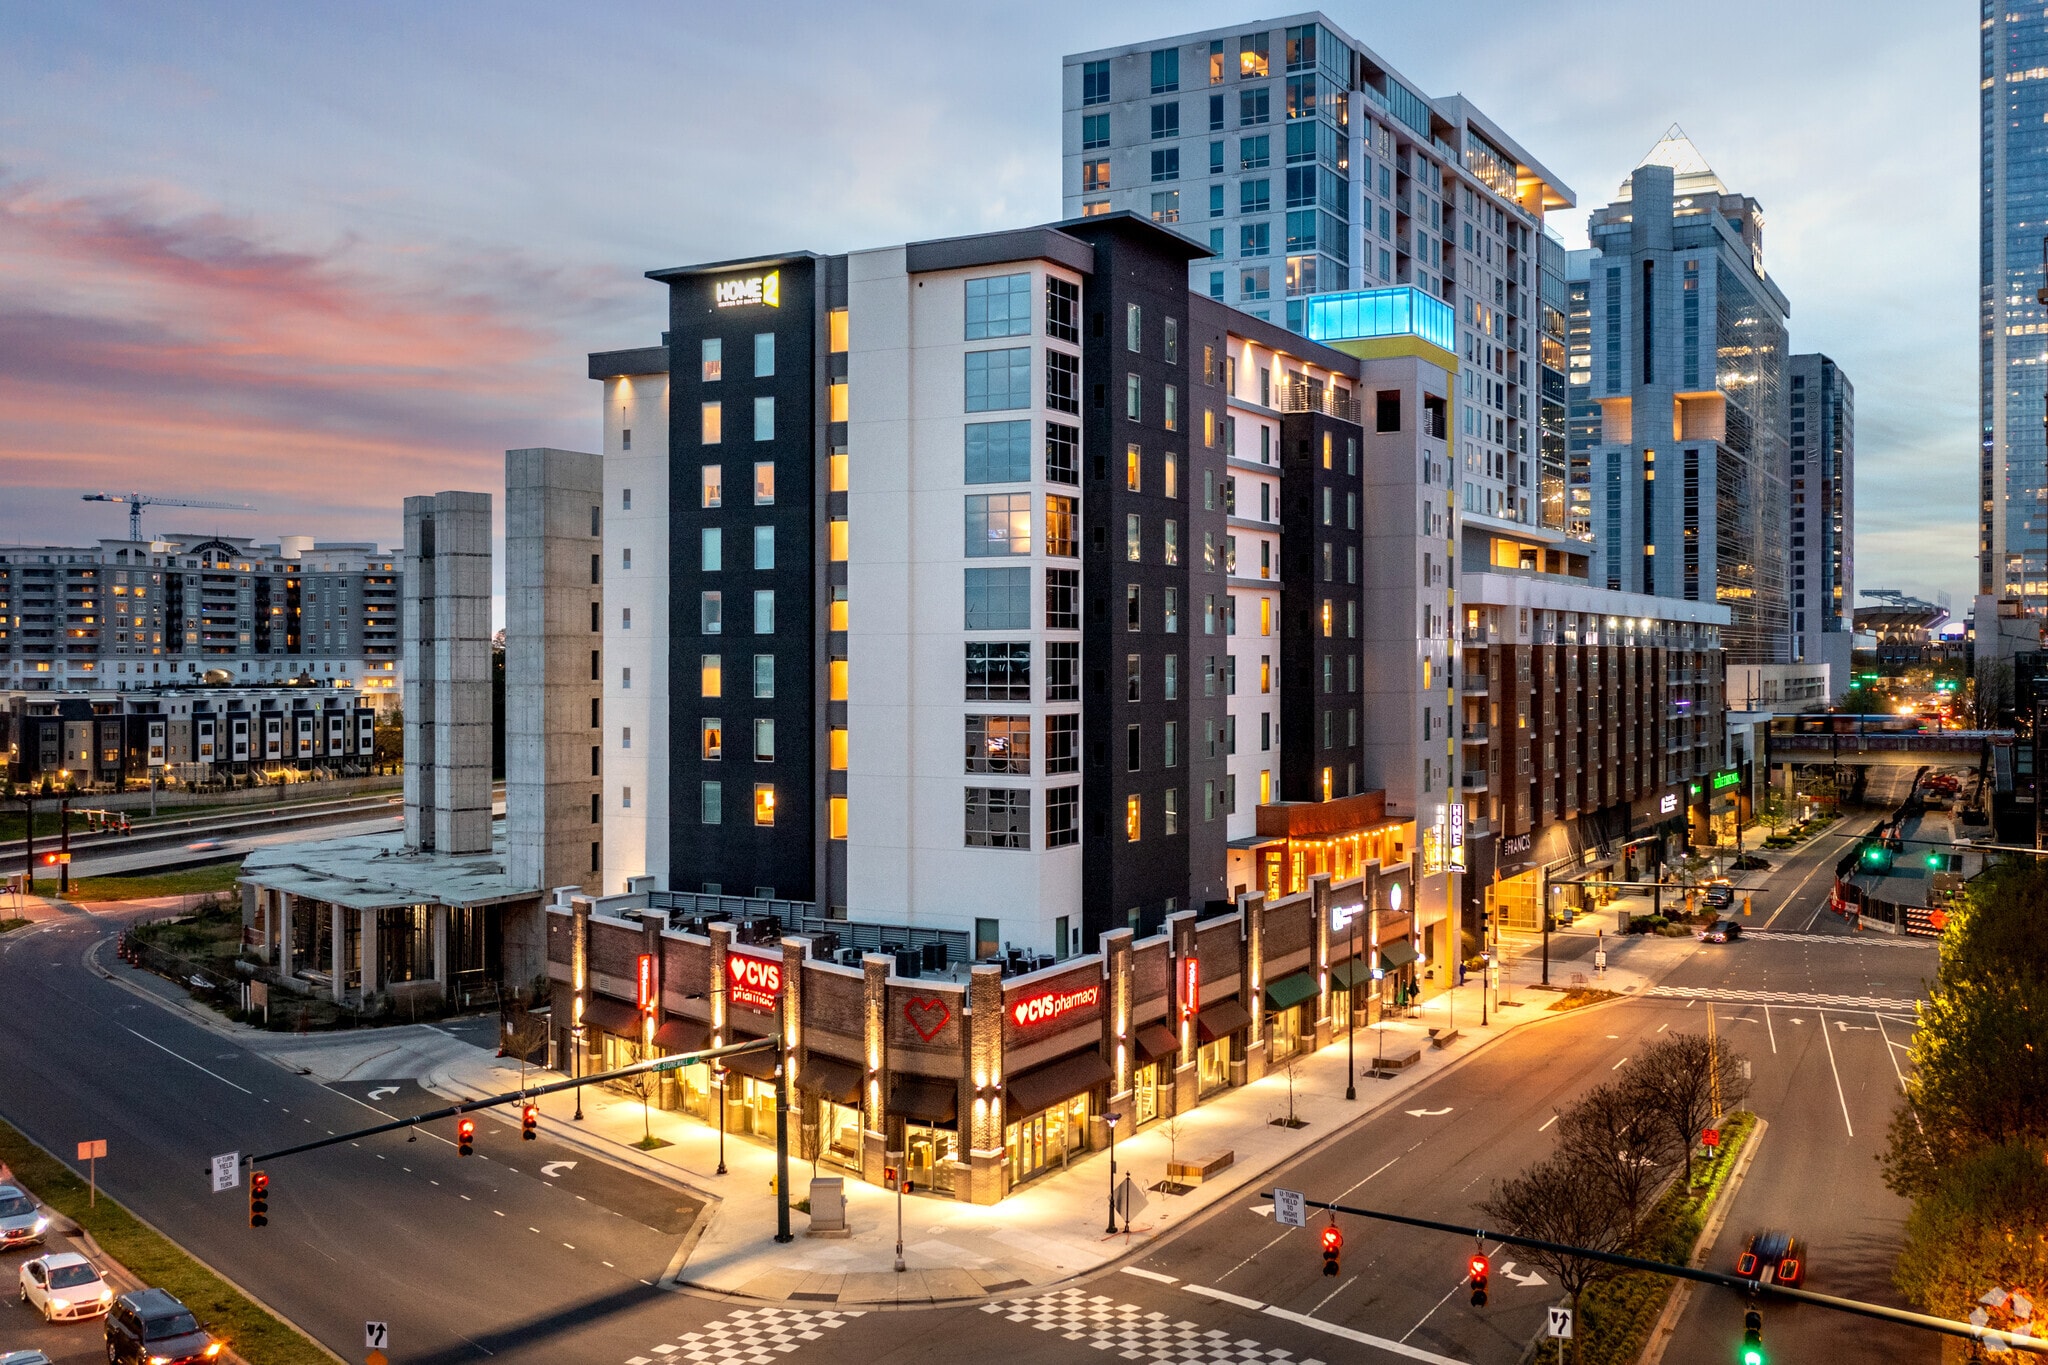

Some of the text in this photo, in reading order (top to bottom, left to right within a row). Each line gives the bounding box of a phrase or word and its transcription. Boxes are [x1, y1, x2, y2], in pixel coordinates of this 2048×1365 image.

[716, 275, 777, 304] HOME 2
[1452, 805, 1462, 846] HOME
[1507, 834, 1531, 856] FRANCIS
[746, 961, 779, 990] CVS
[1028, 986, 1098, 1022] CVS pharmacy
[217, 1155, 235, 1164] U-TURN
[219, 1161, 233, 1169] YIELD
[219, 1174, 232, 1182] RIGHT
[1279, 1190, 1299, 1199] U-TURN
[1282, 1198, 1298, 1206] YIELD
[1282, 1210, 1298, 1218] RIGHT
